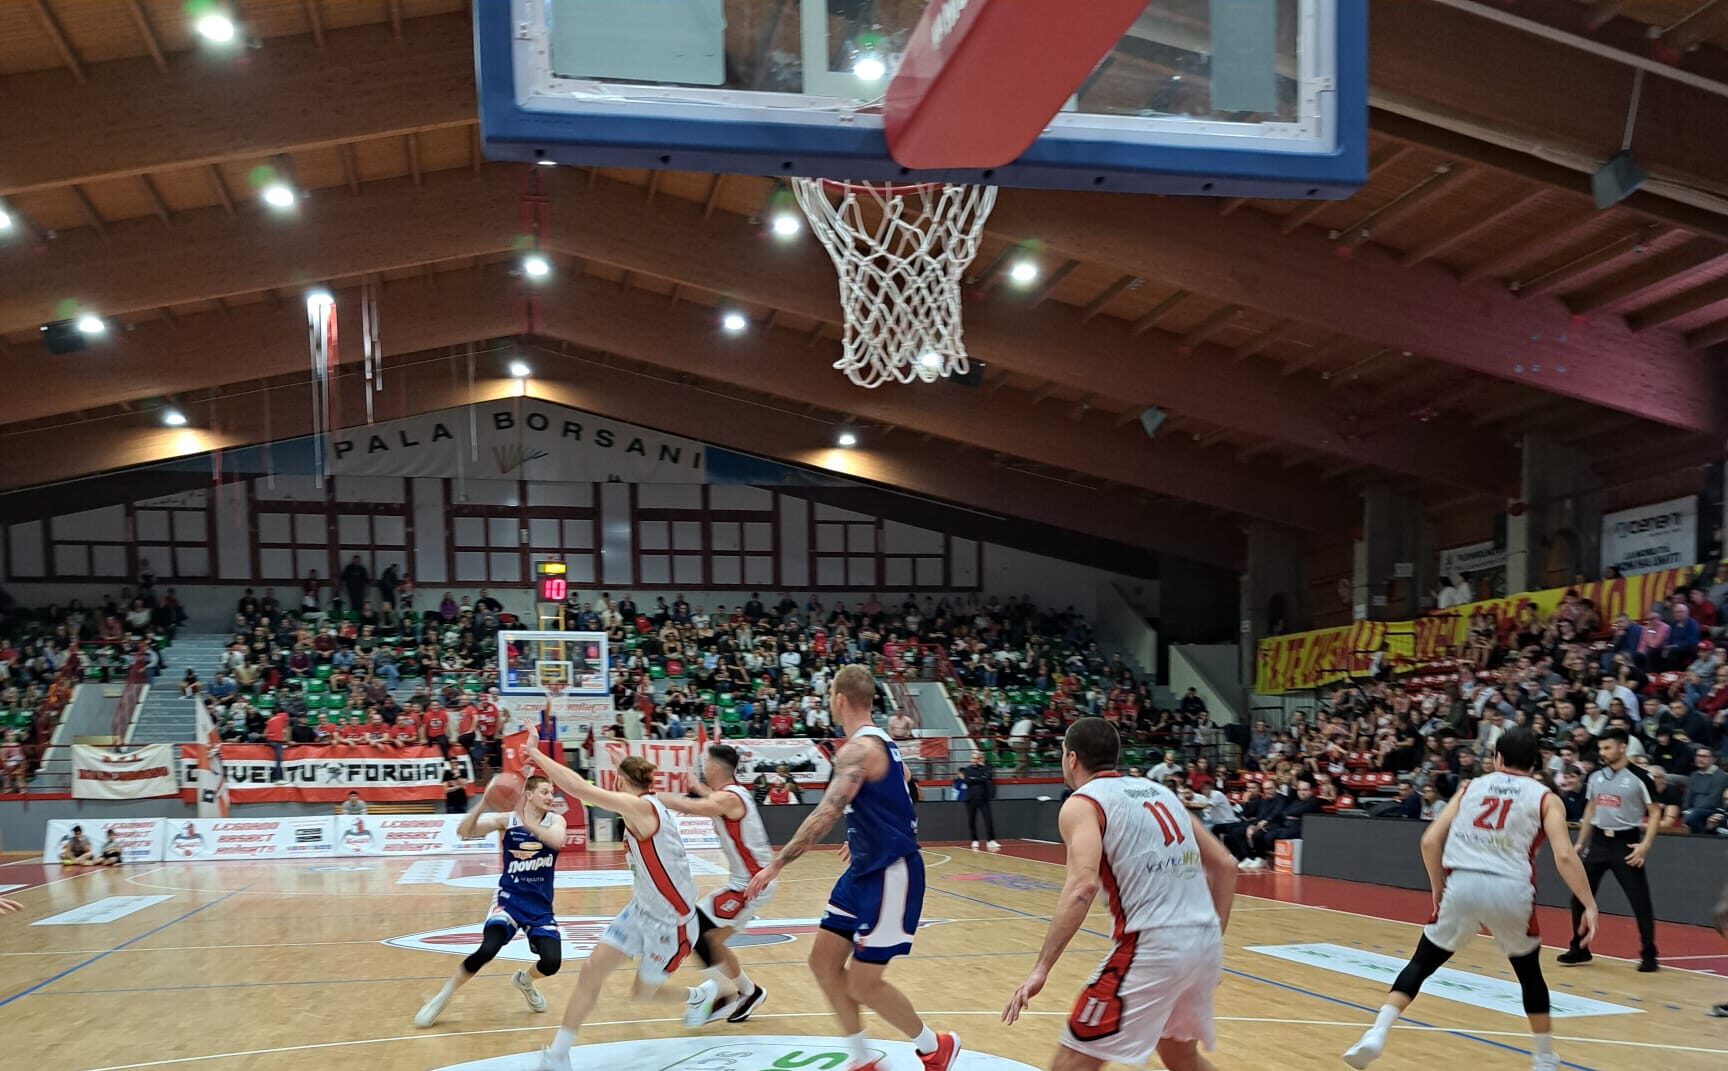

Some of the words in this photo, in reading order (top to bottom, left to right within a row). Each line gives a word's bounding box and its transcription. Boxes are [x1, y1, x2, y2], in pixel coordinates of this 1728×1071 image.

[333, 423, 454, 460] PALA
[493, 411, 701, 469] BORSANI
[545, 578, 567, 600] 10
[1143, 801, 1185, 848] 11
[1473, 795, 1514, 831] 21
[1078, 996, 1108, 1027] 11
